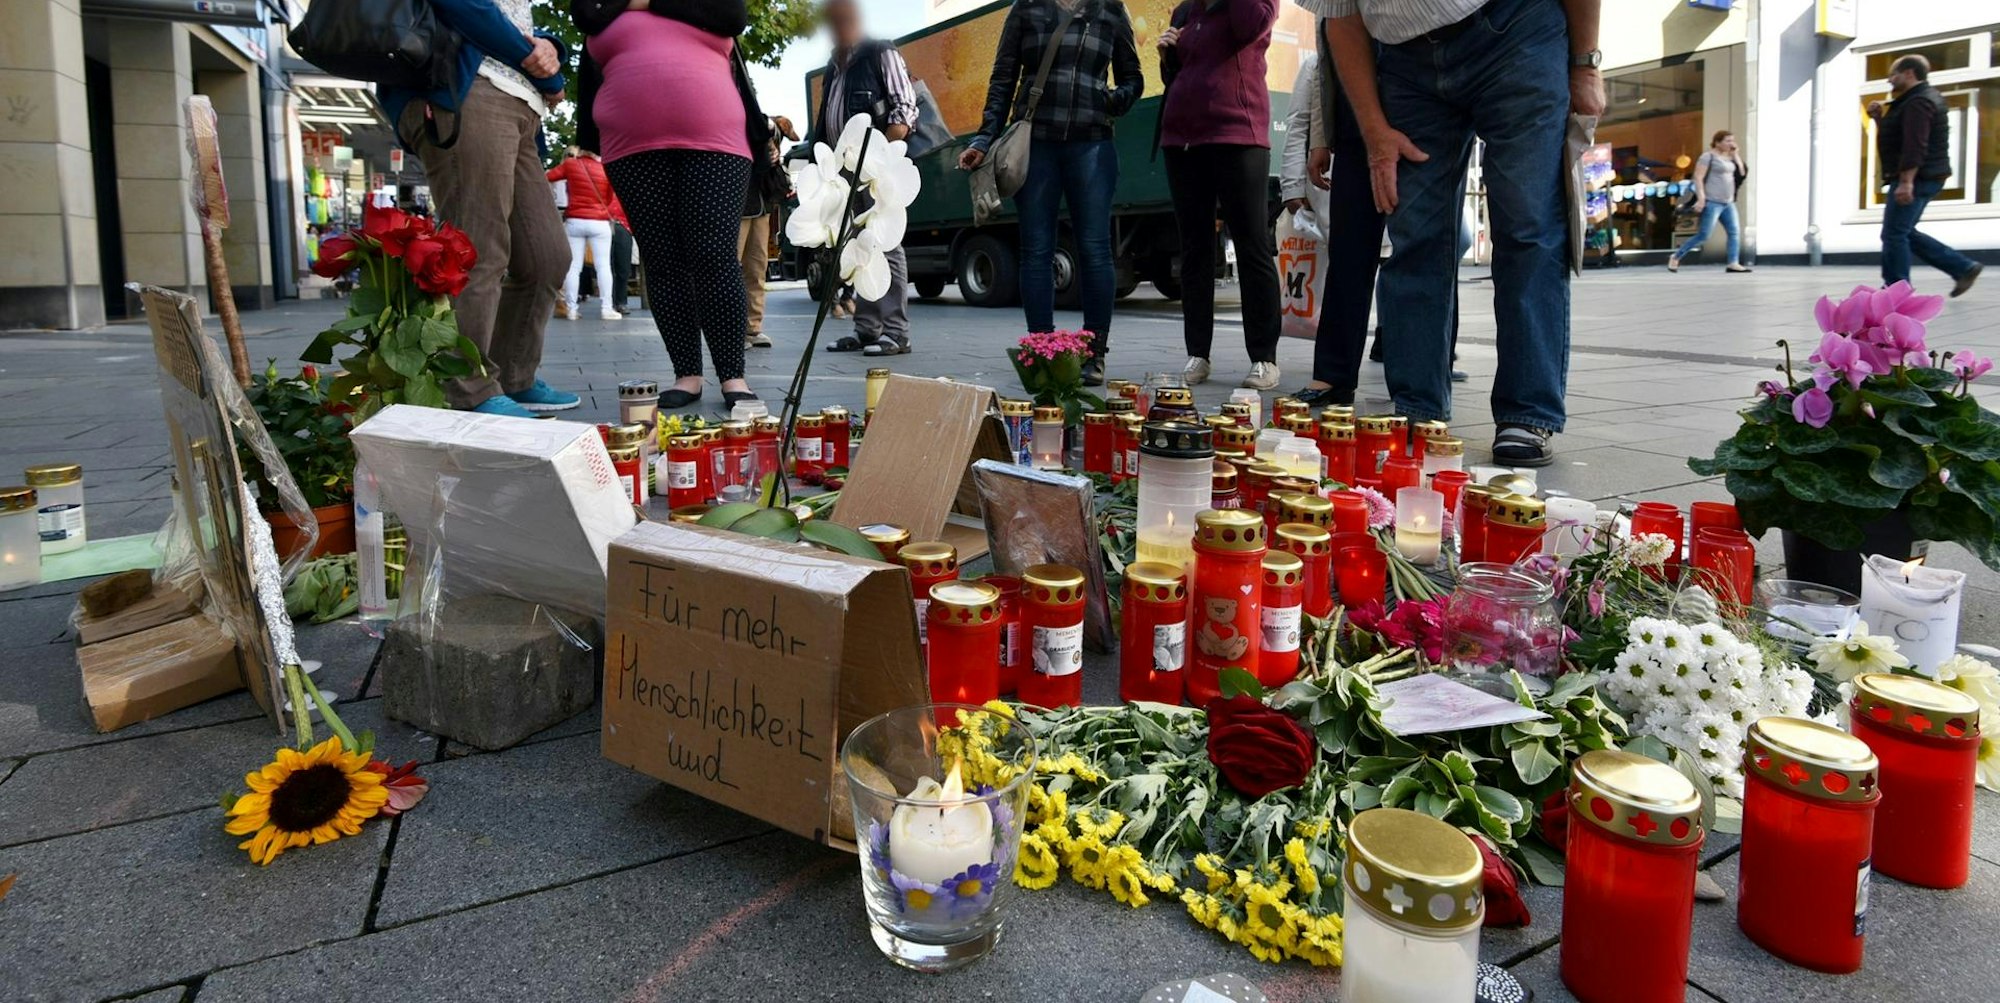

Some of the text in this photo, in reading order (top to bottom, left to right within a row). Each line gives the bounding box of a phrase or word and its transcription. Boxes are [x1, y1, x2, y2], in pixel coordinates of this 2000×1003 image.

[628, 560, 807, 657] Für mehr
[618, 634, 822, 762] Menschlichkeit
[667, 737, 740, 790] und
